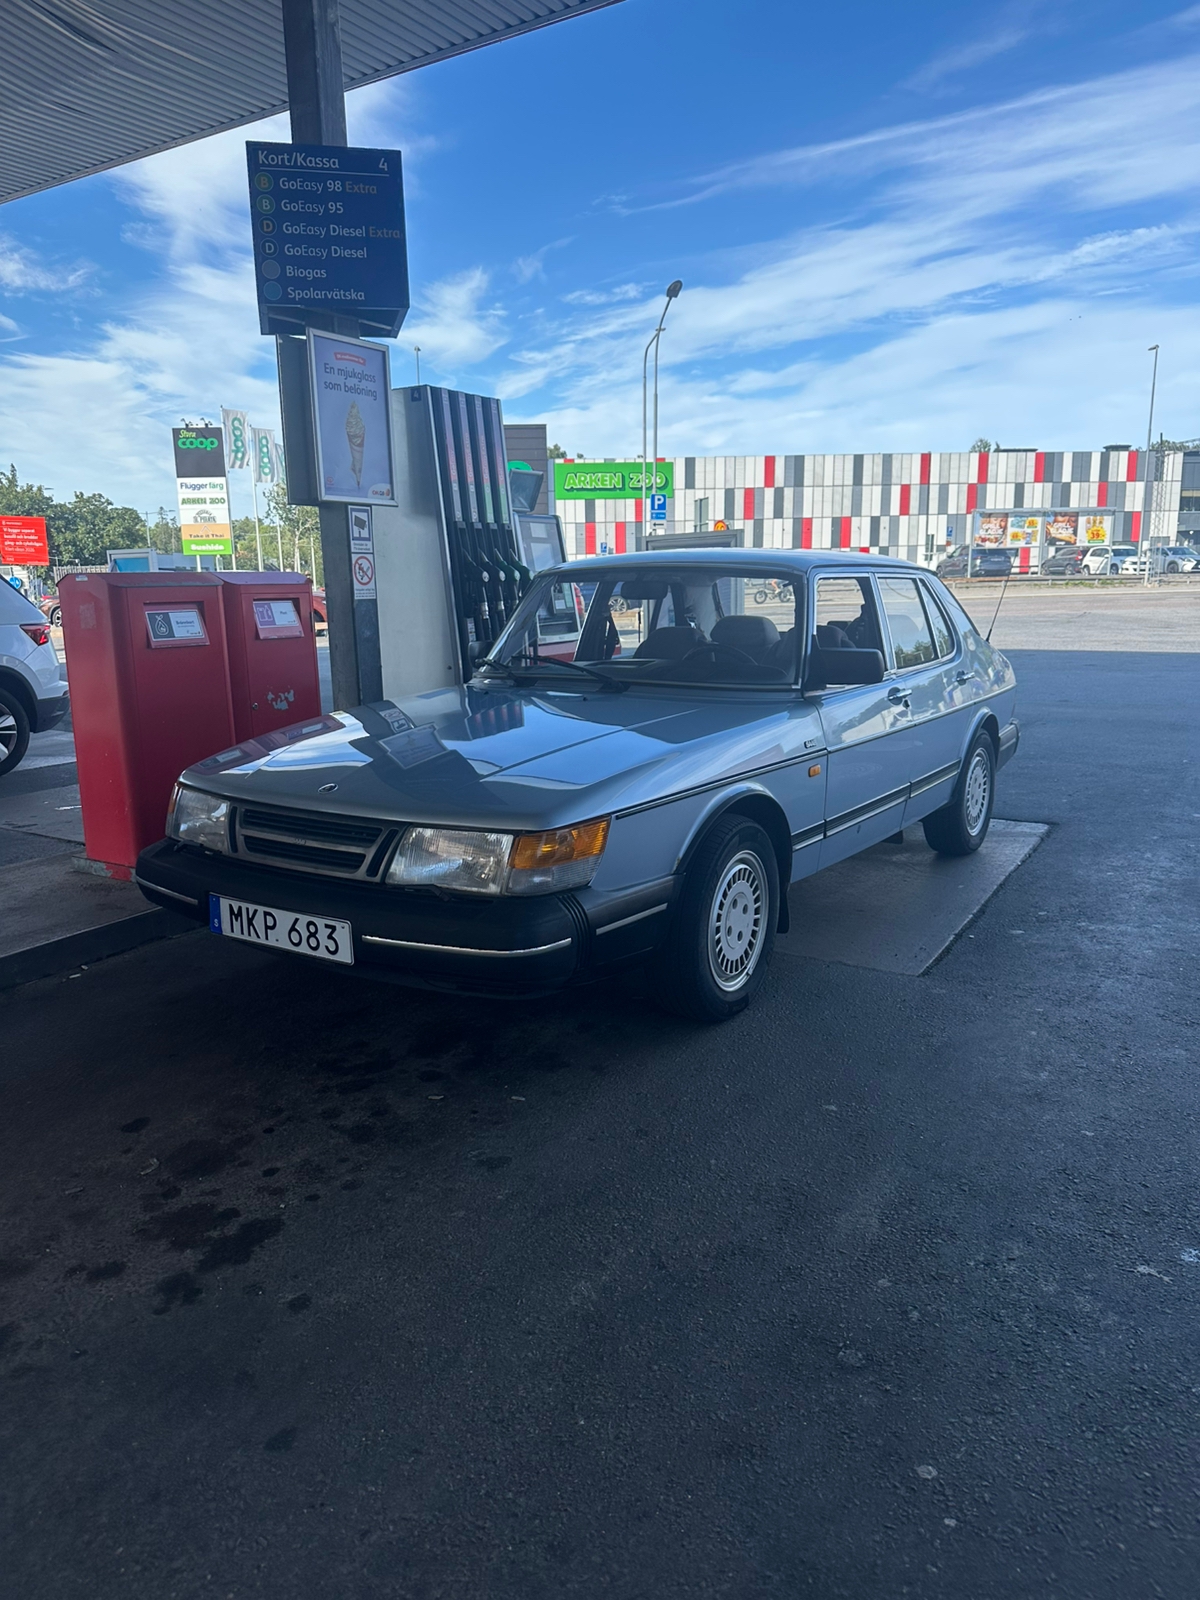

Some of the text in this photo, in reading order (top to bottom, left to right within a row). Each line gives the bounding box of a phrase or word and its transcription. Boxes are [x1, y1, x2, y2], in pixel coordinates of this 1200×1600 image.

[258, 150, 388, 171] Kort/Kassa 4
[260, 177, 377, 194] B GoEasy 98 Extra
[262, 200, 343, 215] B GoEasy 95
[264, 221, 400, 239] D GoEasy Diesel Extra
[265, 243, 367, 259] D GoEasy Diesel
[286, 265, 327, 280] Biogas
[287, 286, 365, 301] Spolarvätska
[323, 363, 376, 384] En mjukglass
[323, 380, 378, 401] som belöning
[177, 437, 219, 451] coop
[180, 481, 224, 491] Flügger färg
[564, 472, 667, 490] ARKEN ZOO
[181, 497, 207, 505] ARKEN
[654, 495, 664, 510] P
[228, 903, 339, 955] MKP 683
